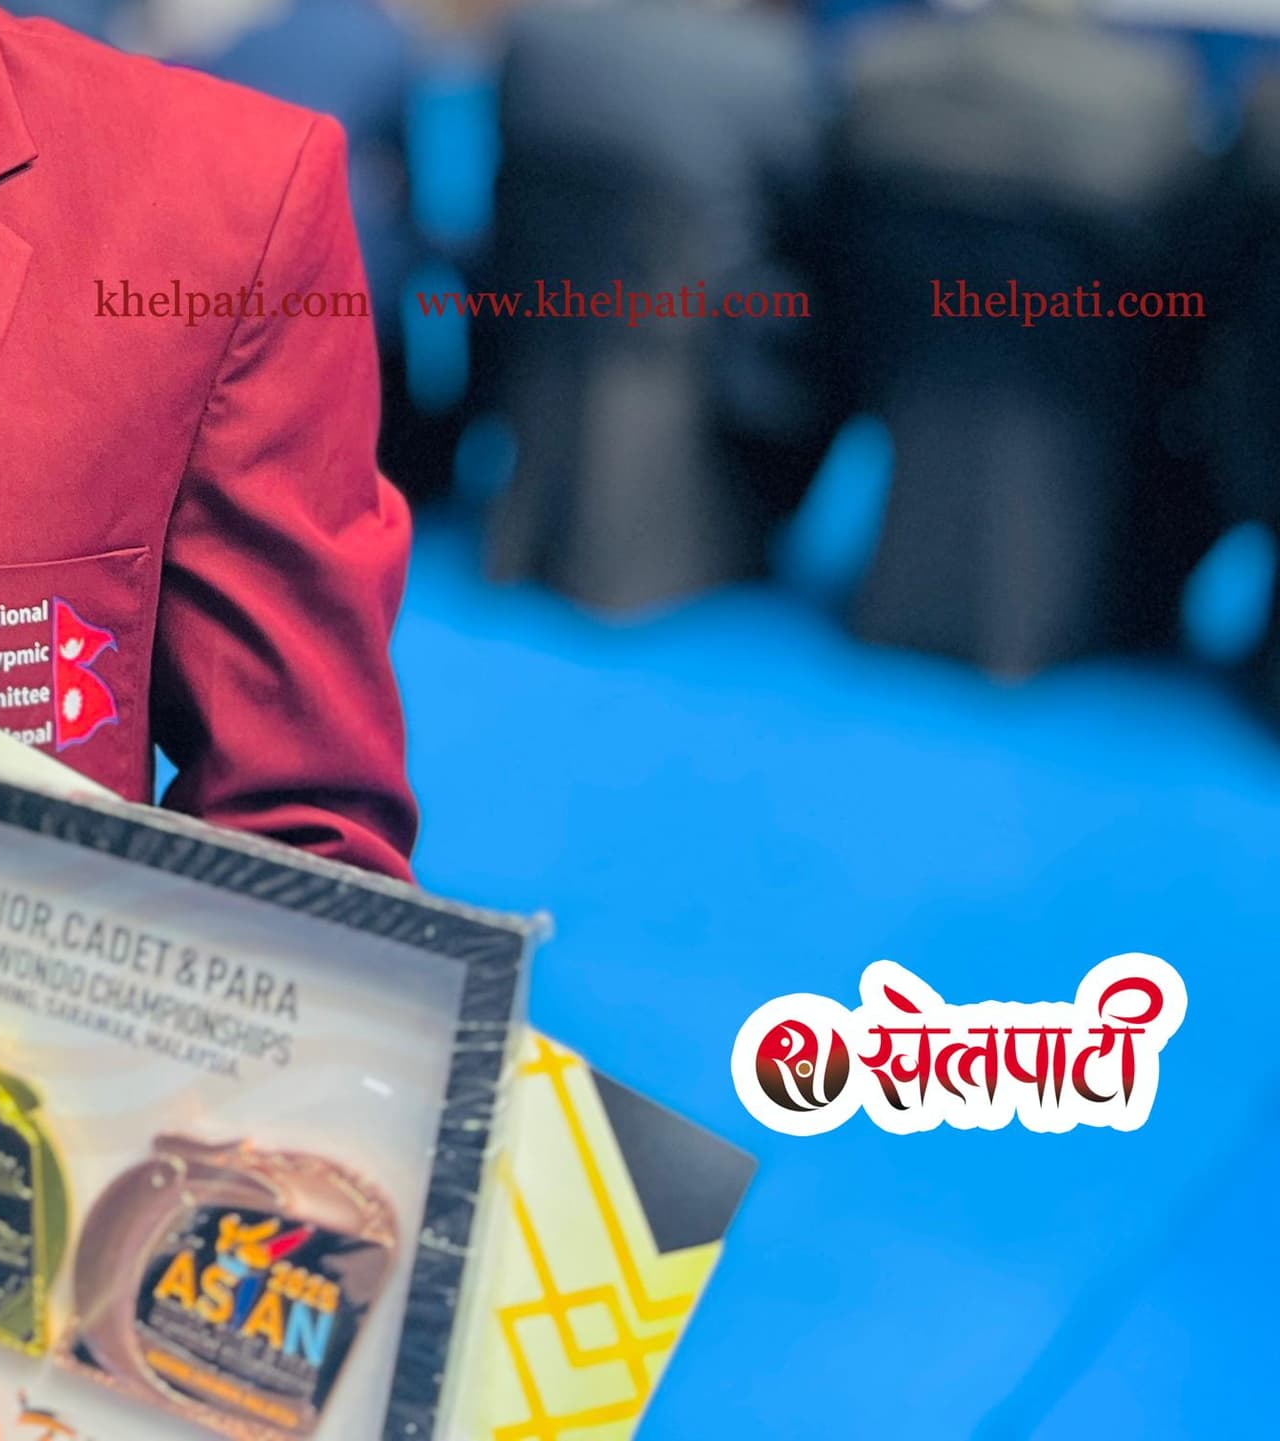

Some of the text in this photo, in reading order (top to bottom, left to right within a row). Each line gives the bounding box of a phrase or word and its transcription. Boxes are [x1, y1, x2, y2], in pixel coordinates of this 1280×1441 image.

[3, 721, 53, 747] epal
[60, 910, 173, 977] CADET
[174, 947, 199, 988] &
[203, 955, 300, 1022] PARA
[88, 970, 294, 1067] CHAMPIONSHIPS
[153, 1249, 336, 1368] ASIAN
